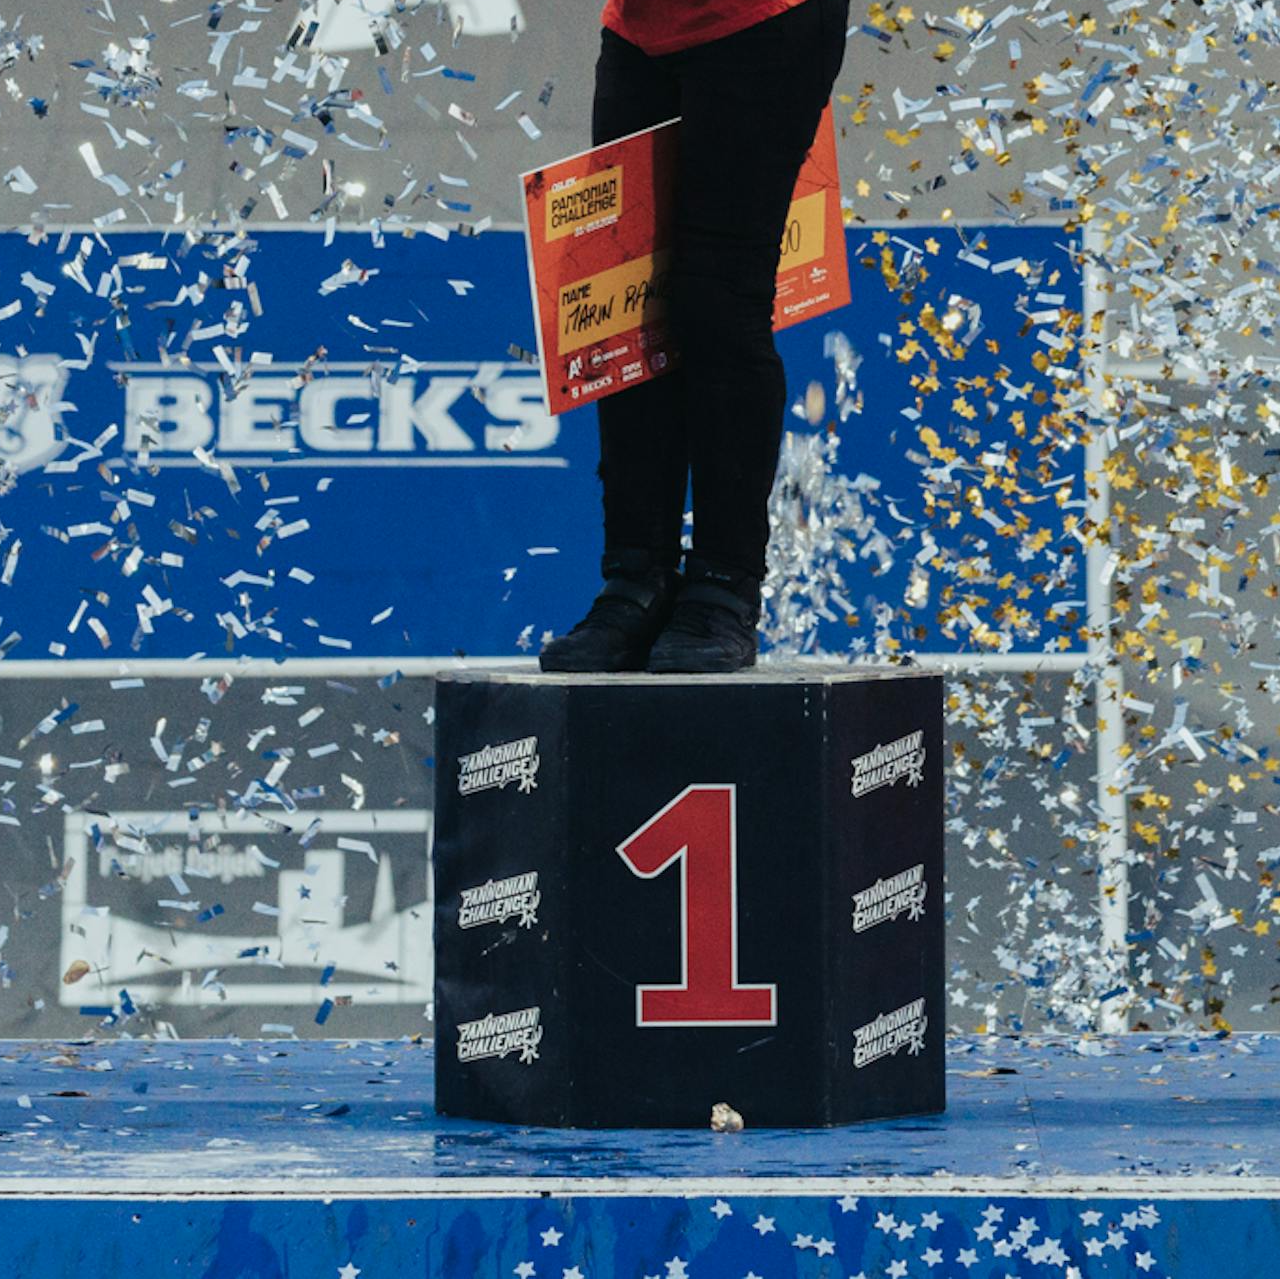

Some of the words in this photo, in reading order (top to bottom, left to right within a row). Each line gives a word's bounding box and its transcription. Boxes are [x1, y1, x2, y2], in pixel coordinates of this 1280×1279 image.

[551, 193, 617, 229] CHALLENGE
[552, 178, 617, 215] PANNONIAN
[562, 283, 592, 307] NAME
[125, 363, 561, 452] BECK'S
[457, 756, 532, 792] CHALLENGE
[458, 892, 532, 927] CHALLENGE
[616, 784, 777, 1027] 1
[456, 1027, 535, 1061] CHALLENGE
